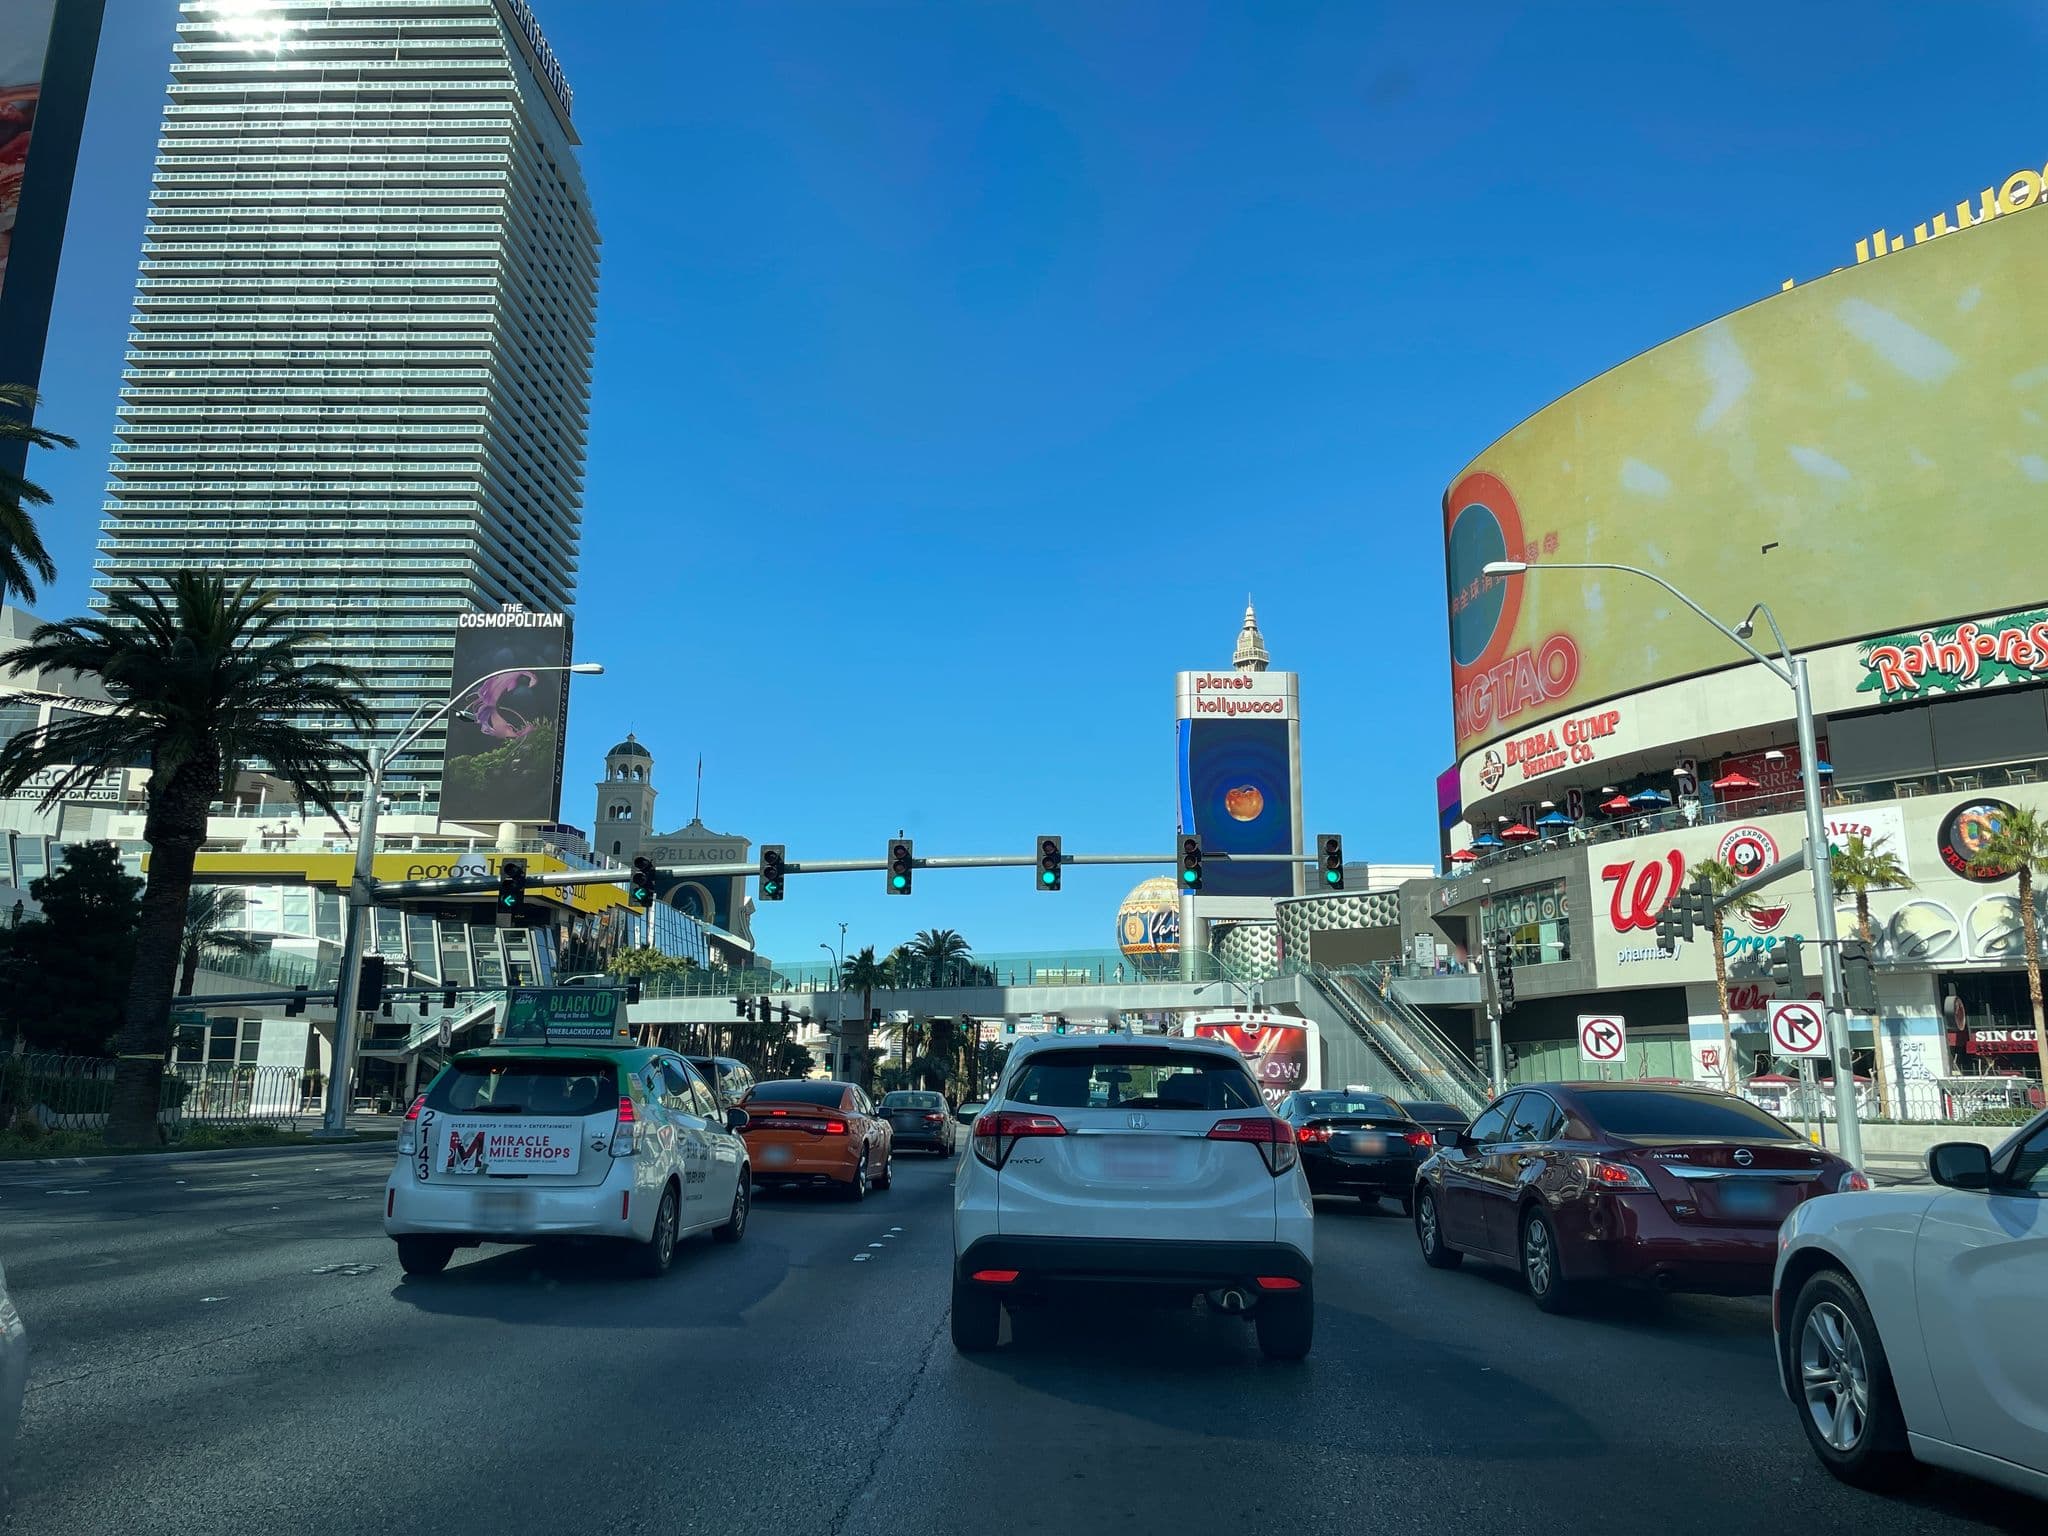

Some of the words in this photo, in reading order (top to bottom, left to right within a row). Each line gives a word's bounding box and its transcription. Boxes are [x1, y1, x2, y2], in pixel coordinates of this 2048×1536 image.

[502, 604, 523, 613] THE
[459, 613, 563, 628] COSMOPOLITAN
[1196, 674, 1254, 692] planet
[1196, 697, 1285, 717] hollywood
[1505, 730, 1560, 767] BUBBA
[1562, 711, 1621, 747] GUMP
[1522, 750, 1569, 780] SHRIMP
[1570, 743, 1595, 764] CO.
[1721, 833, 1740, 857] PANDA
[1741, 829, 1772, 852] EXPRESS
[652, 847, 737, 861] BELLAGIO
[546, 1028, 611, 1036] DINEBLACKOUT.COM
[1975, 1030, 2008, 1042] SIN
[2011, 1030, 2039, 1042] CIT
[1901, 1054, 1922, 1070] 24
[418, 1111, 435, 1180] 2143
[490, 1135, 550, 1147] MIRACLE
[489, 1148, 519, 1158] MILE
[524, 1147, 571, 1159] SHOPS
